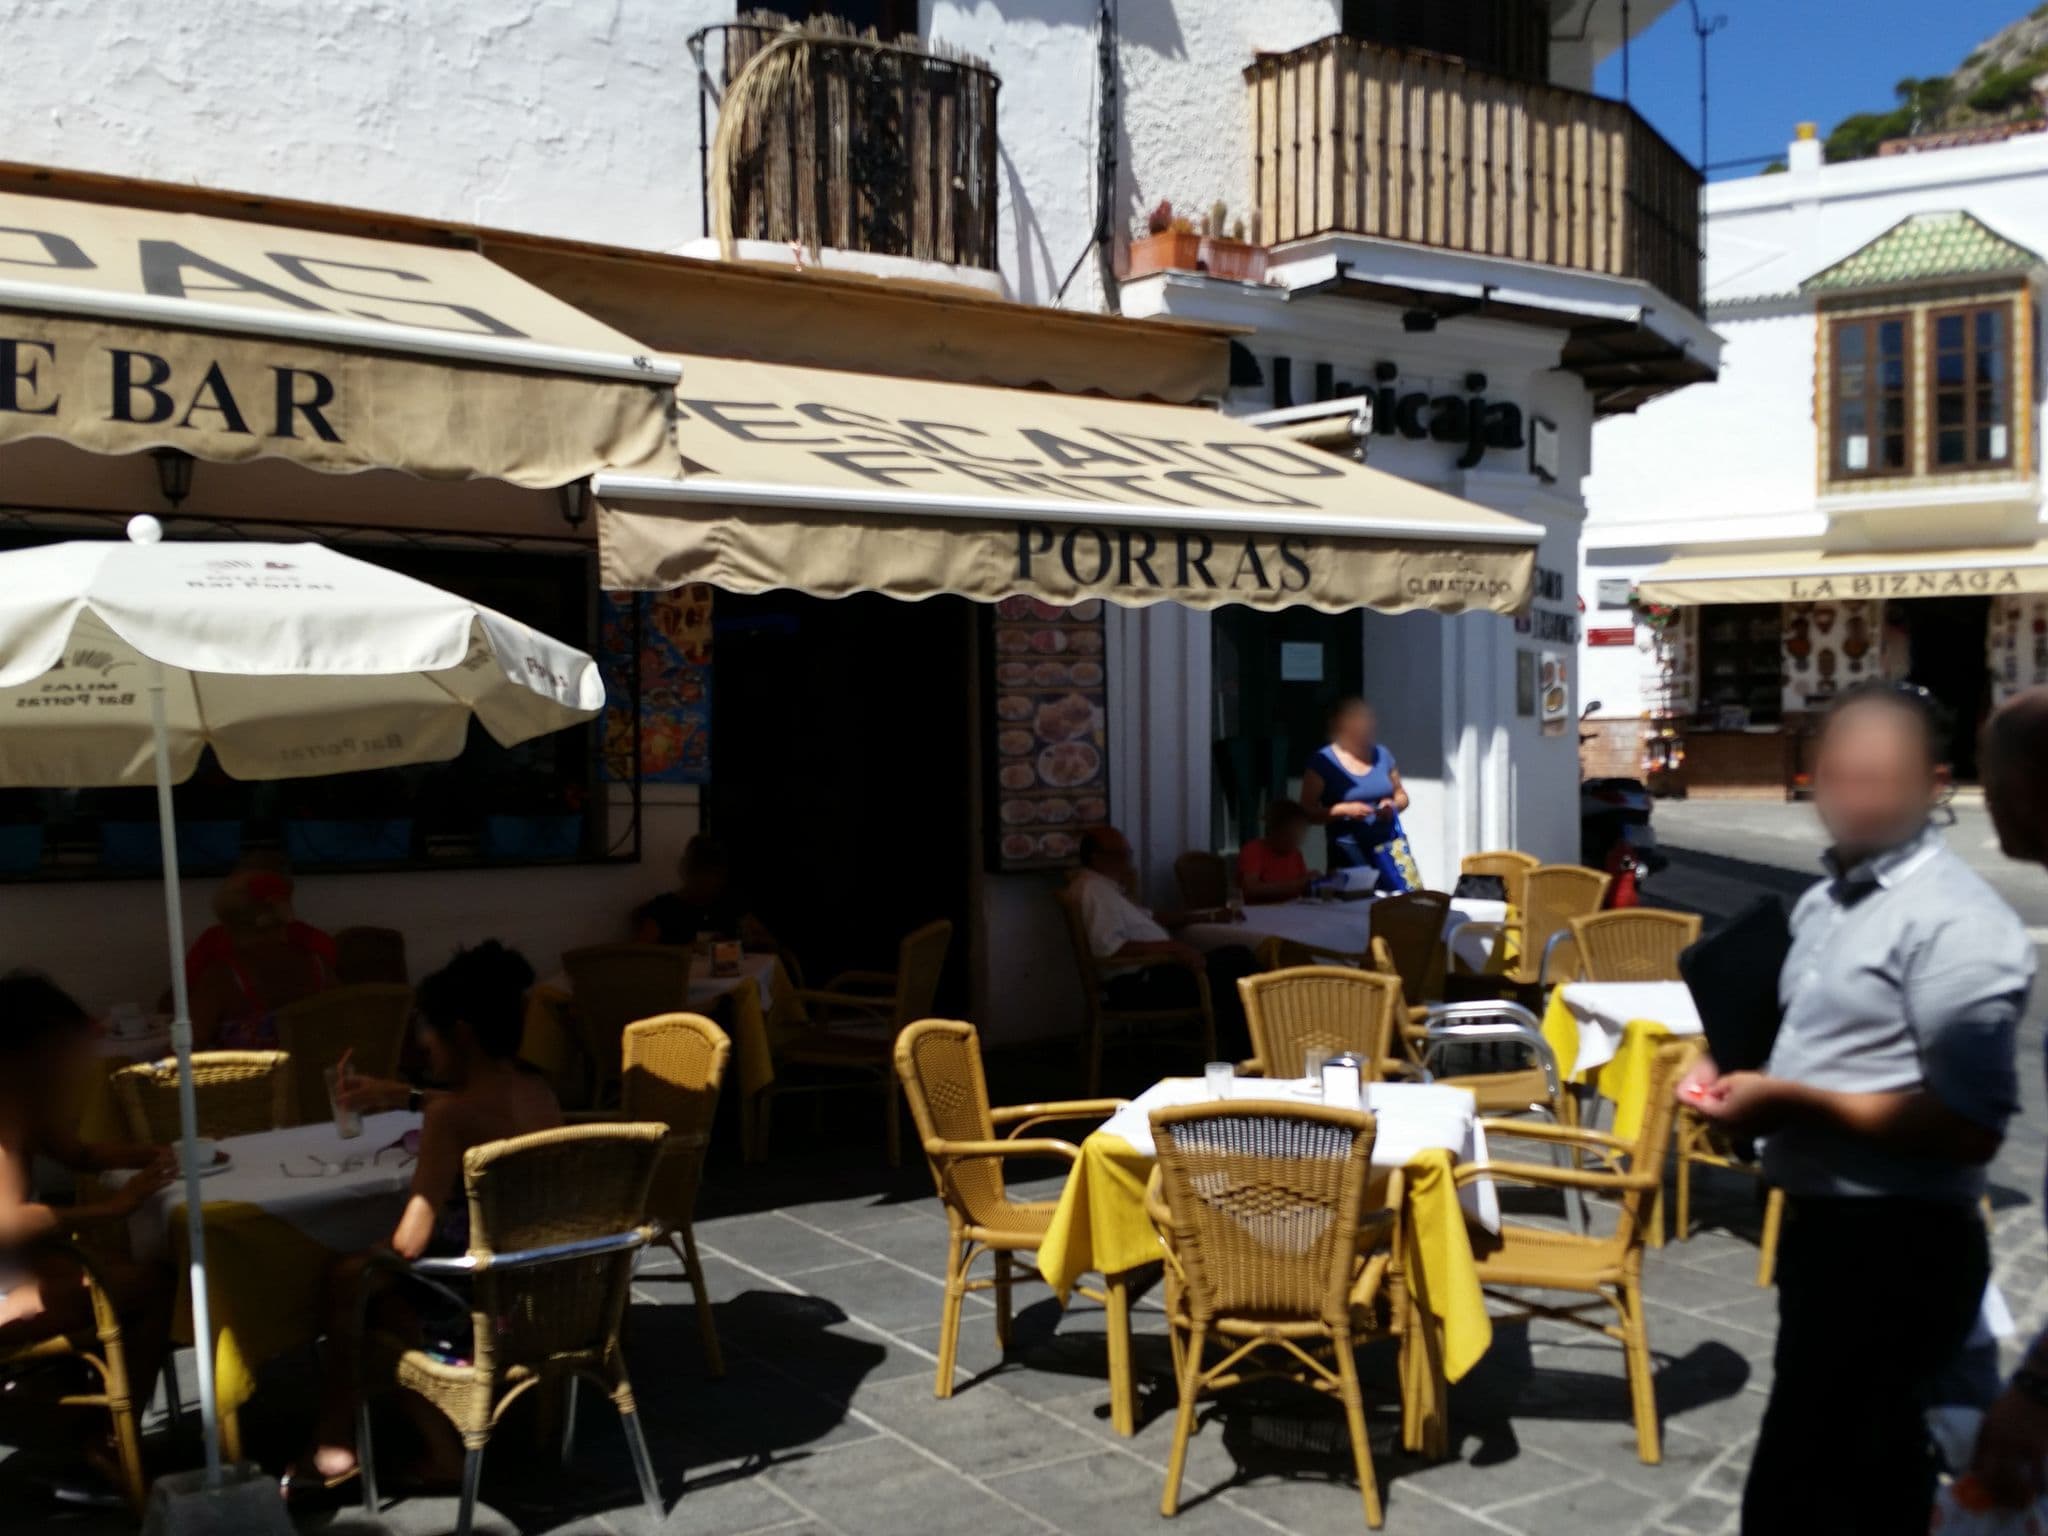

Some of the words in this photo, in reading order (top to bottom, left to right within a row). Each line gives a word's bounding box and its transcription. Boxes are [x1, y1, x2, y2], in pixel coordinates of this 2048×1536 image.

[102, 347, 344, 443] BAR
[677, 398, 1346, 478] ESCAITO
[1014, 520, 1312, 592] PORRAS
[1789, 578, 1834, 598] LA
[1852, 571, 2020, 596] BIZNAGA
